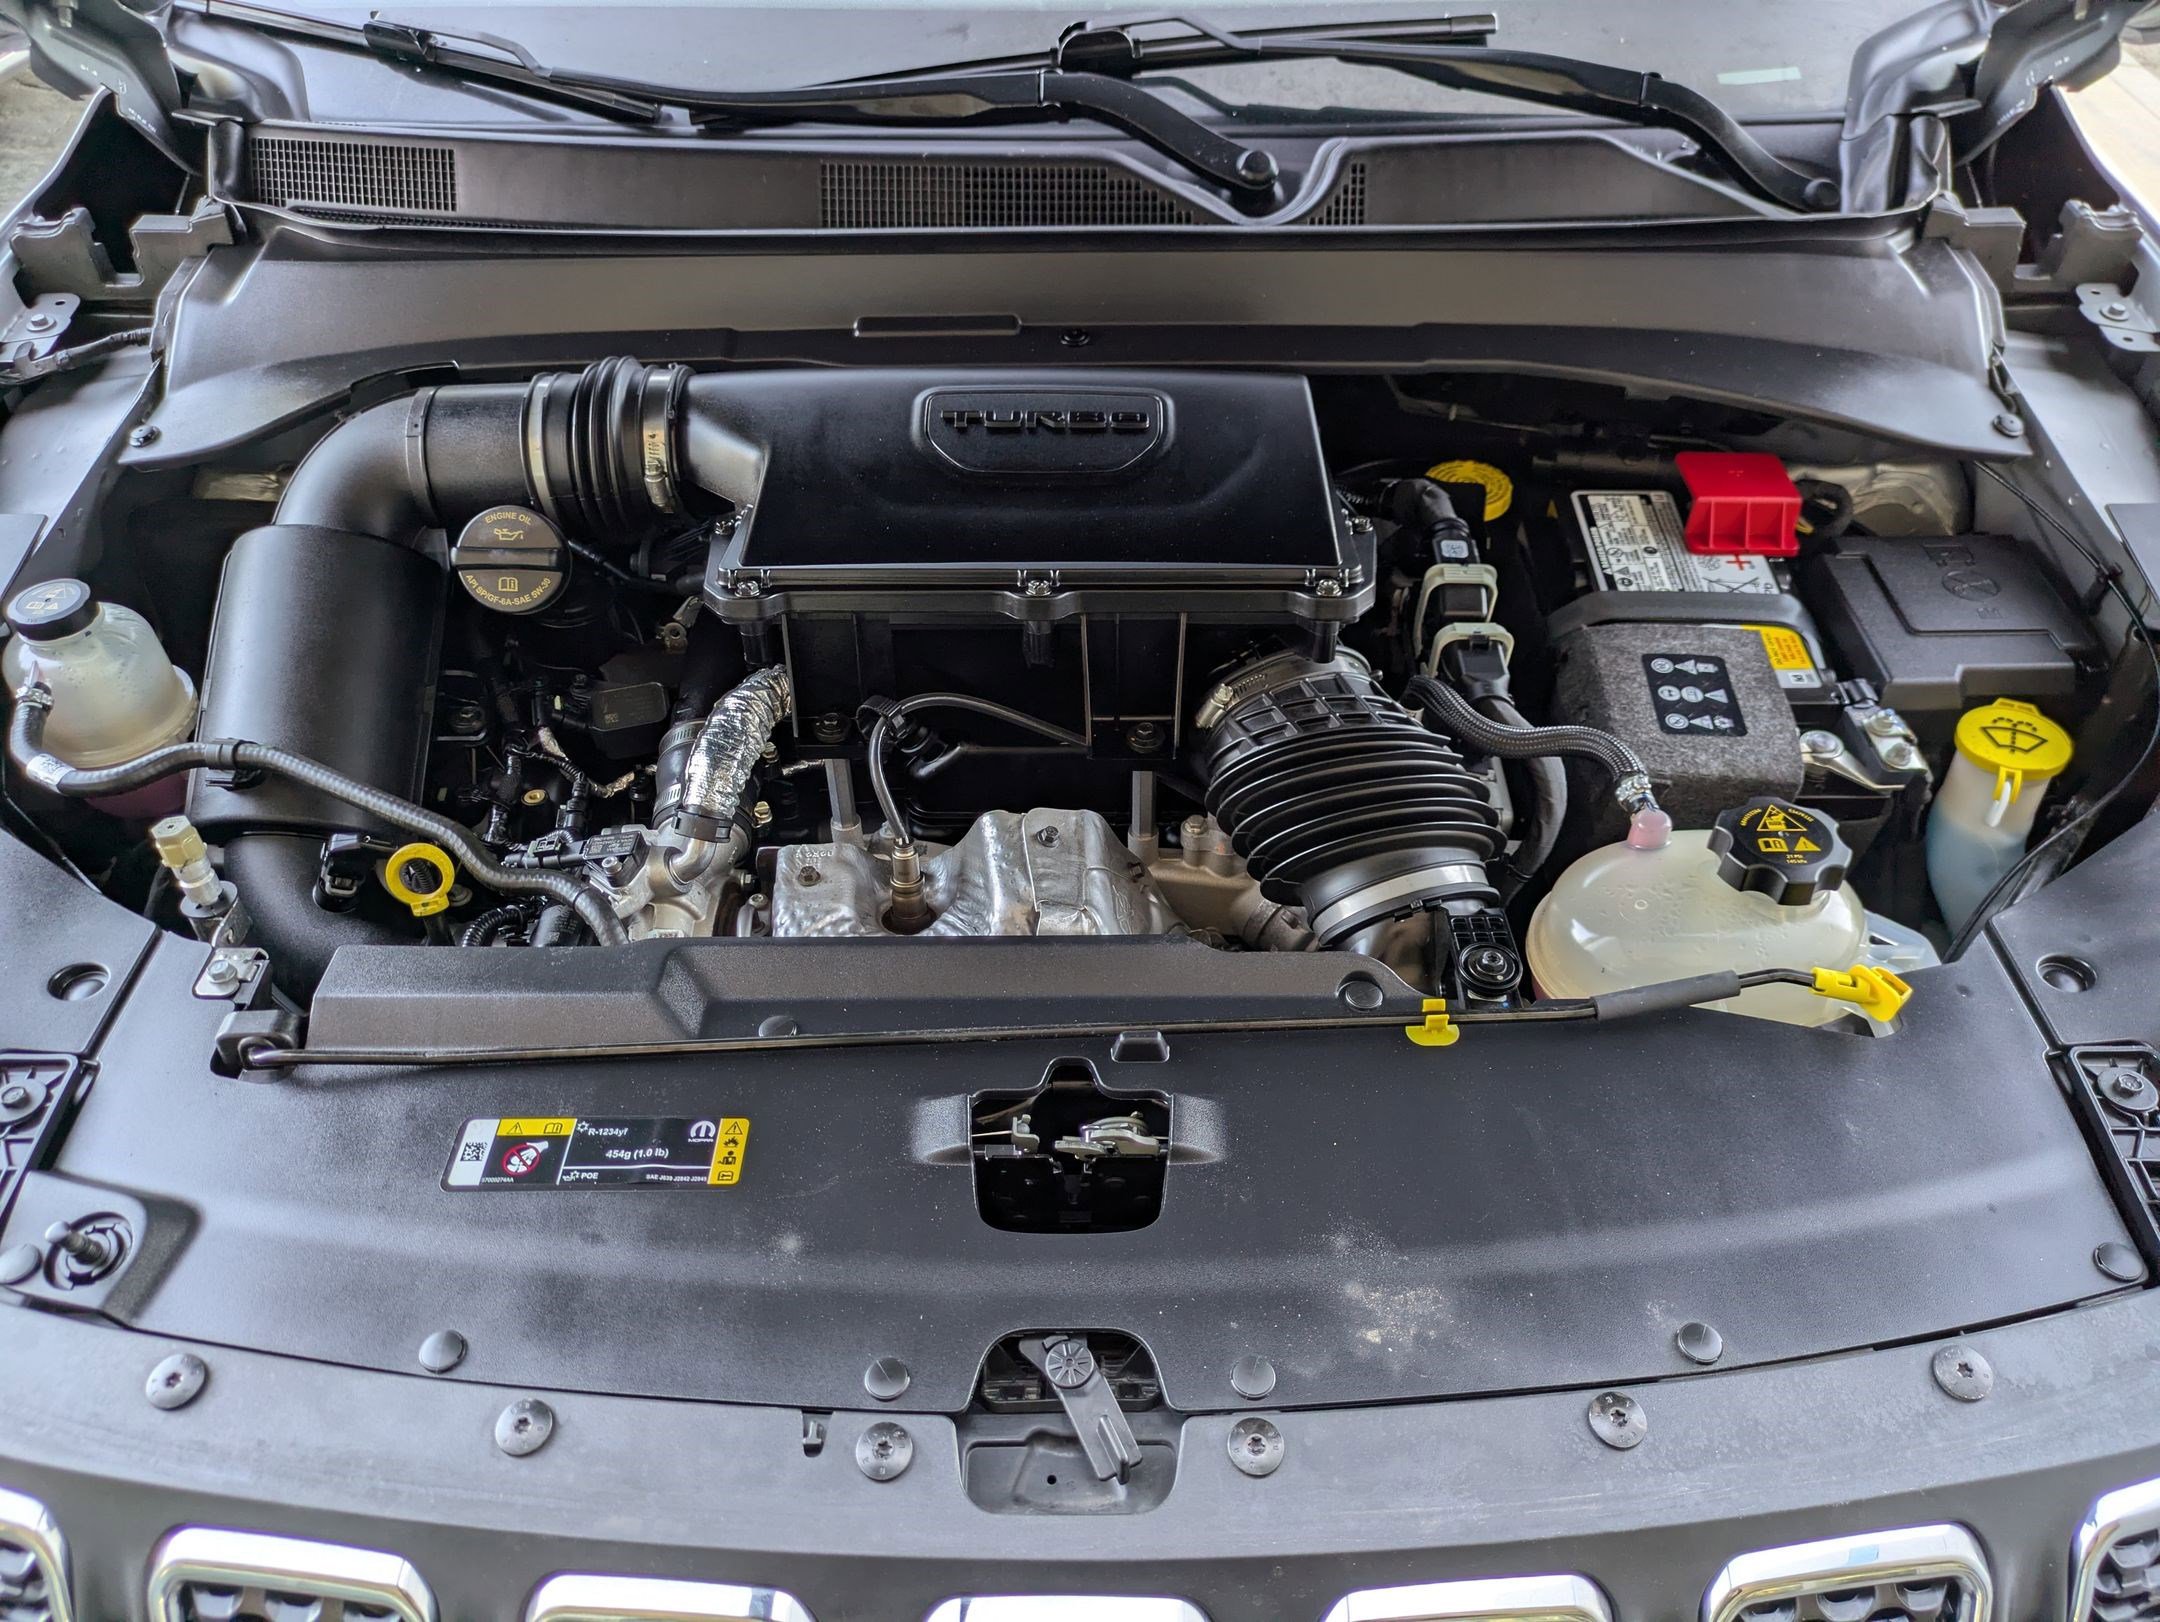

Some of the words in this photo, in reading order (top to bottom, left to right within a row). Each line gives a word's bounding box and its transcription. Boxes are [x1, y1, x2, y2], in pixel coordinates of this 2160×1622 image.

[941, 410, 1150, 429] TURBO
[484, 511, 517, 524] ENGINE
[518, 514, 532, 525] OIL
[466, 575, 479, 588] API
[588, 1127, 629, 1137] R-1234yf
[605, 1149, 632, 1160] 454g
[633, 1148, 653, 1160] (1.0
[654, 1147, 670, 1159] lb)
